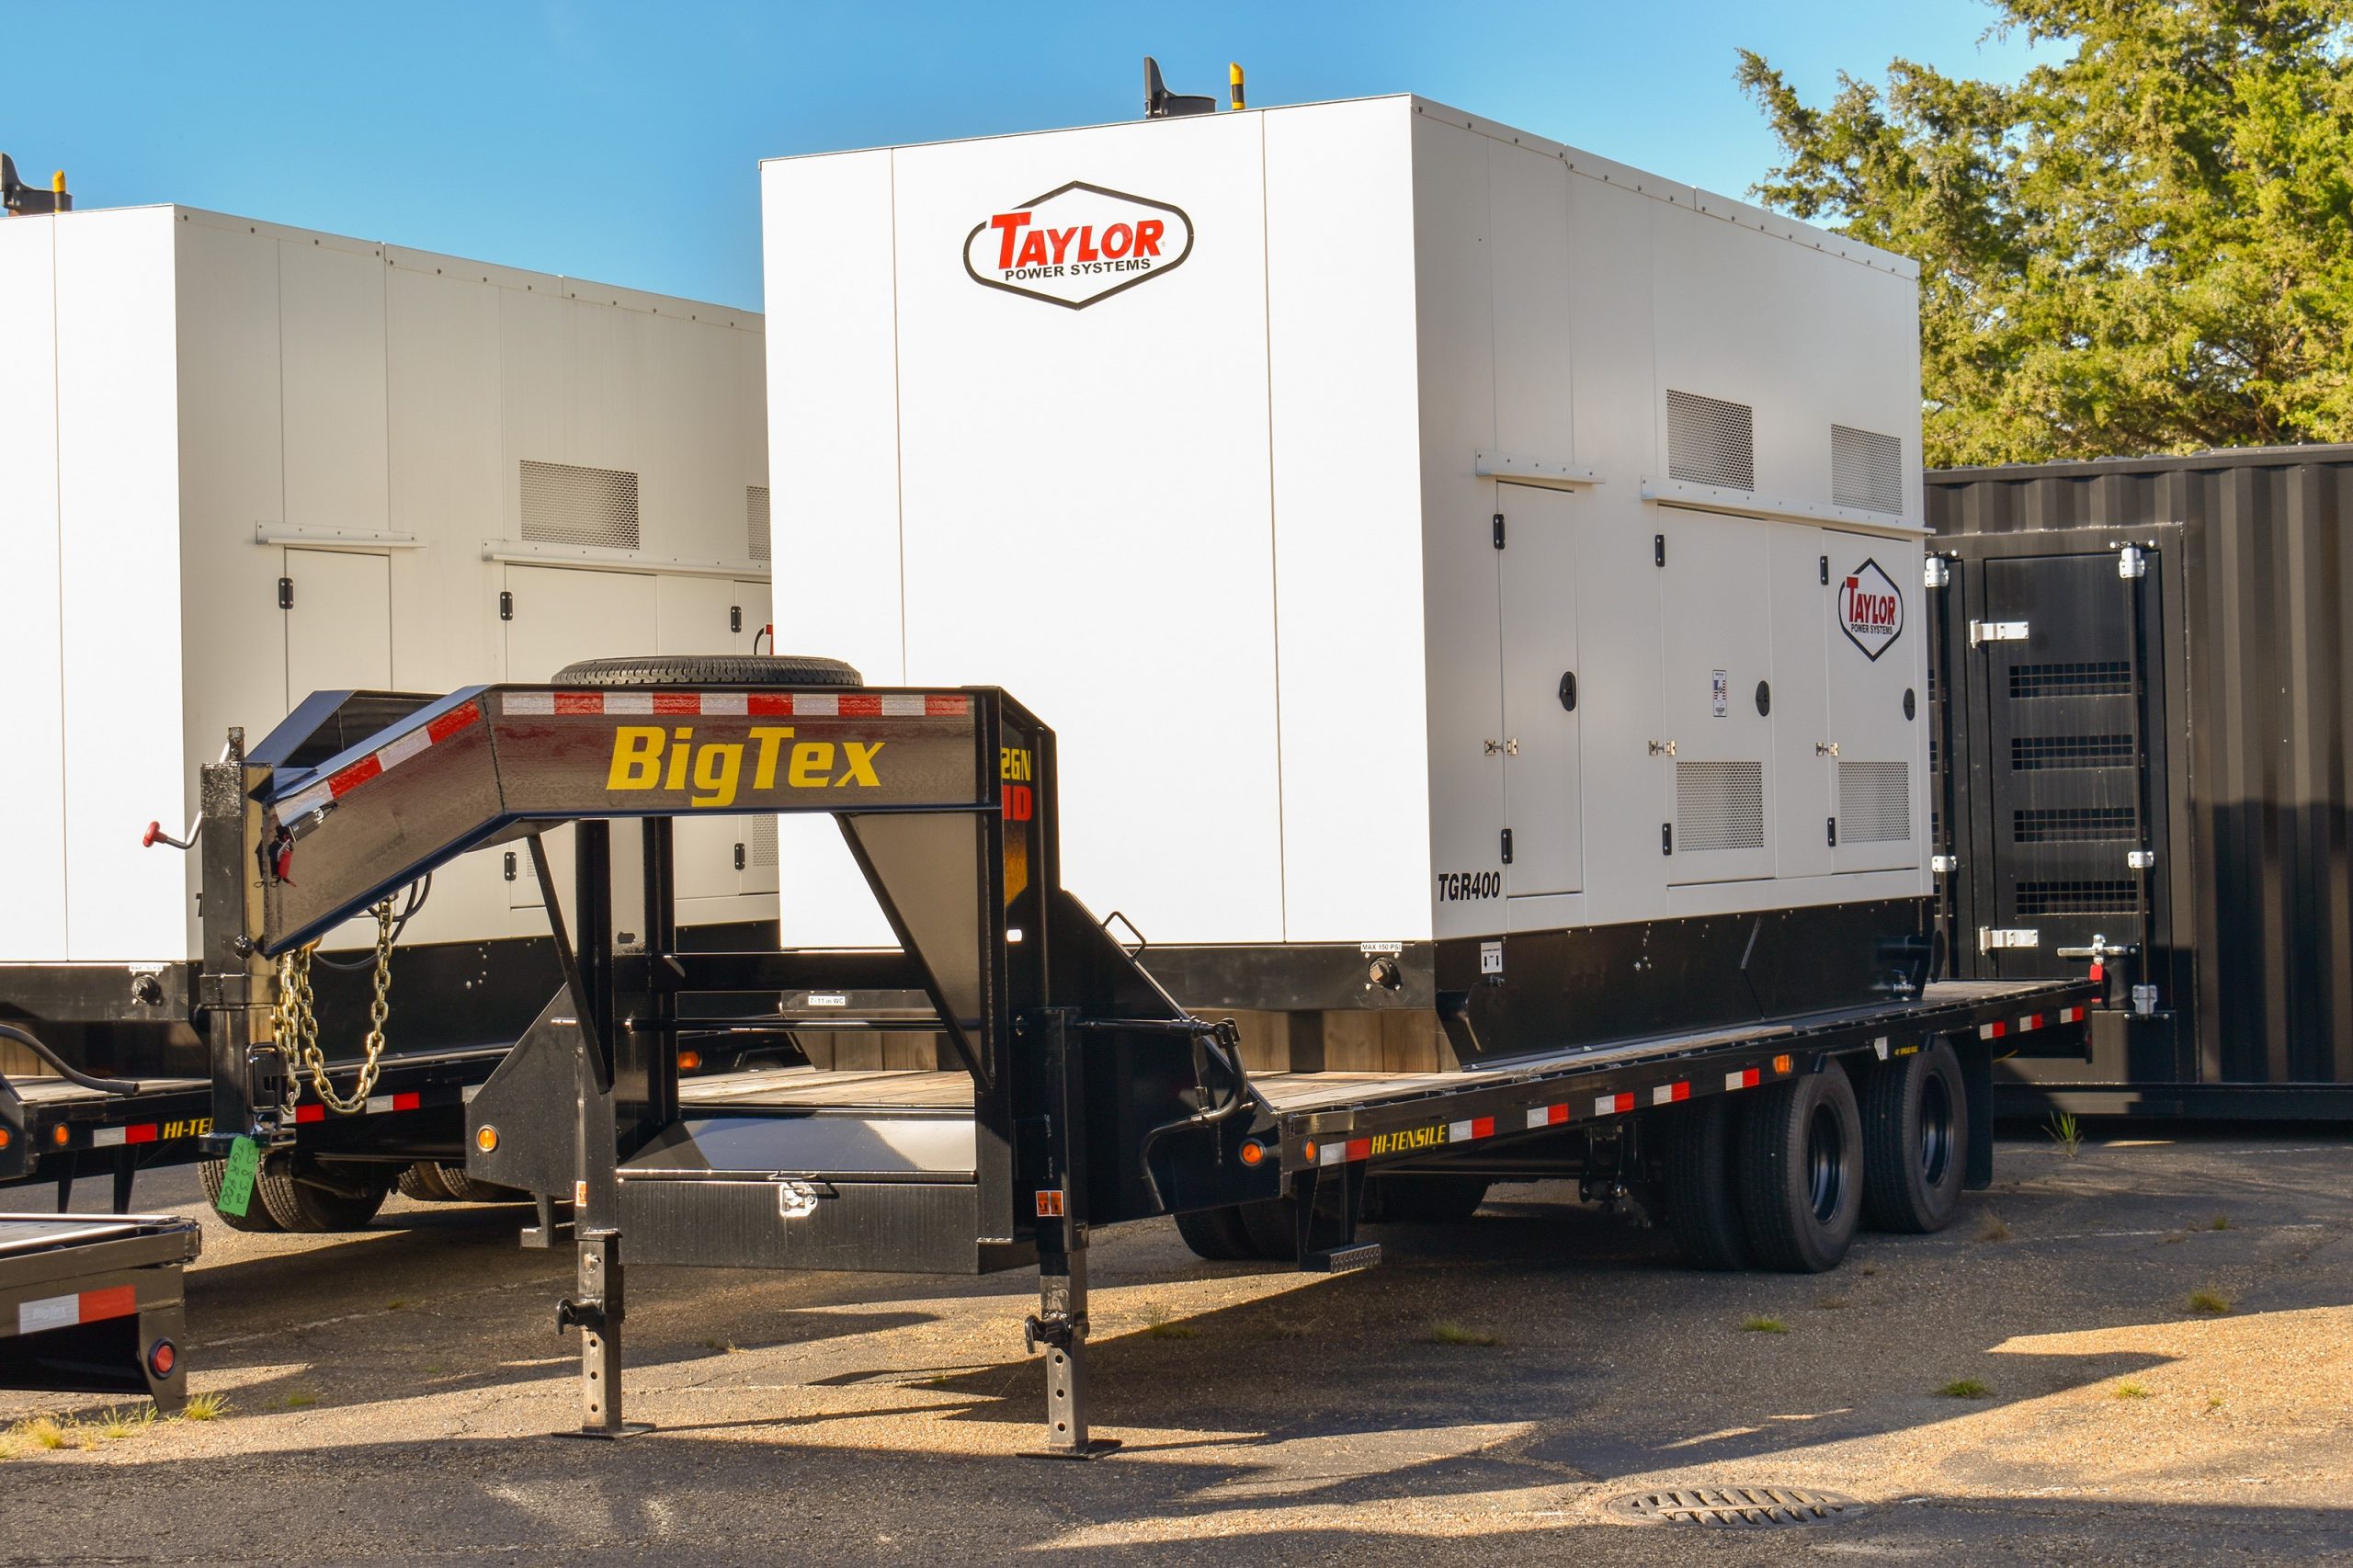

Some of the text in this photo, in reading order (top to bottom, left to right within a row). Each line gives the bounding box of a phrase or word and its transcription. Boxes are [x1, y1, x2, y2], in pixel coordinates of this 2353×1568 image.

[991, 211, 1165, 269] TAYLOR
[1005, 258, 1151, 281] POWER SYSTEMS
[1846, 576, 1896, 625] TAYLOR
[1850, 624, 1893, 635] POWER SYSTEMS
[606, 726, 886, 807] BigTex
[1438, 871, 1501, 902] TGR400
[163, 1118, 213, 1140] HI-TE
[1370, 1124, 1447, 1154] HI-TENSILE
